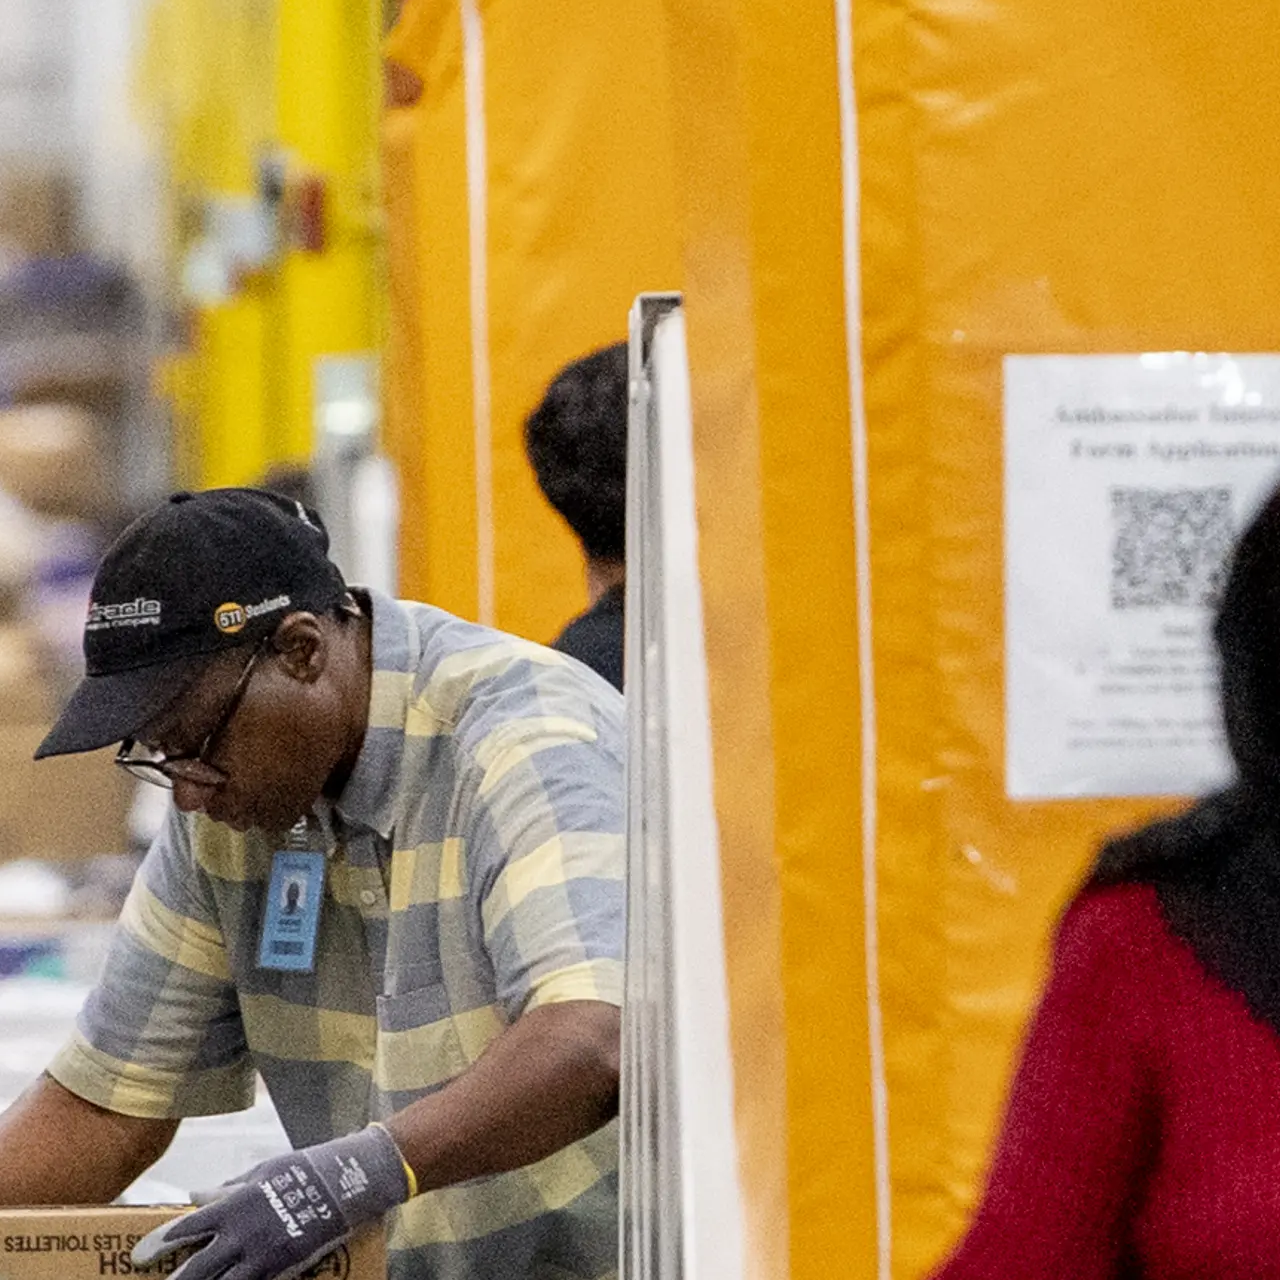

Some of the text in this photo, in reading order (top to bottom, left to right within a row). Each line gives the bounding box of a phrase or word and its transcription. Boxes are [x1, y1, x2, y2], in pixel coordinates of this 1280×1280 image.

[4, 1235, 89, 1252] TOILETTES
[94, 1234, 121, 1250] LES
[99, 1251, 179, 1276] FSH
